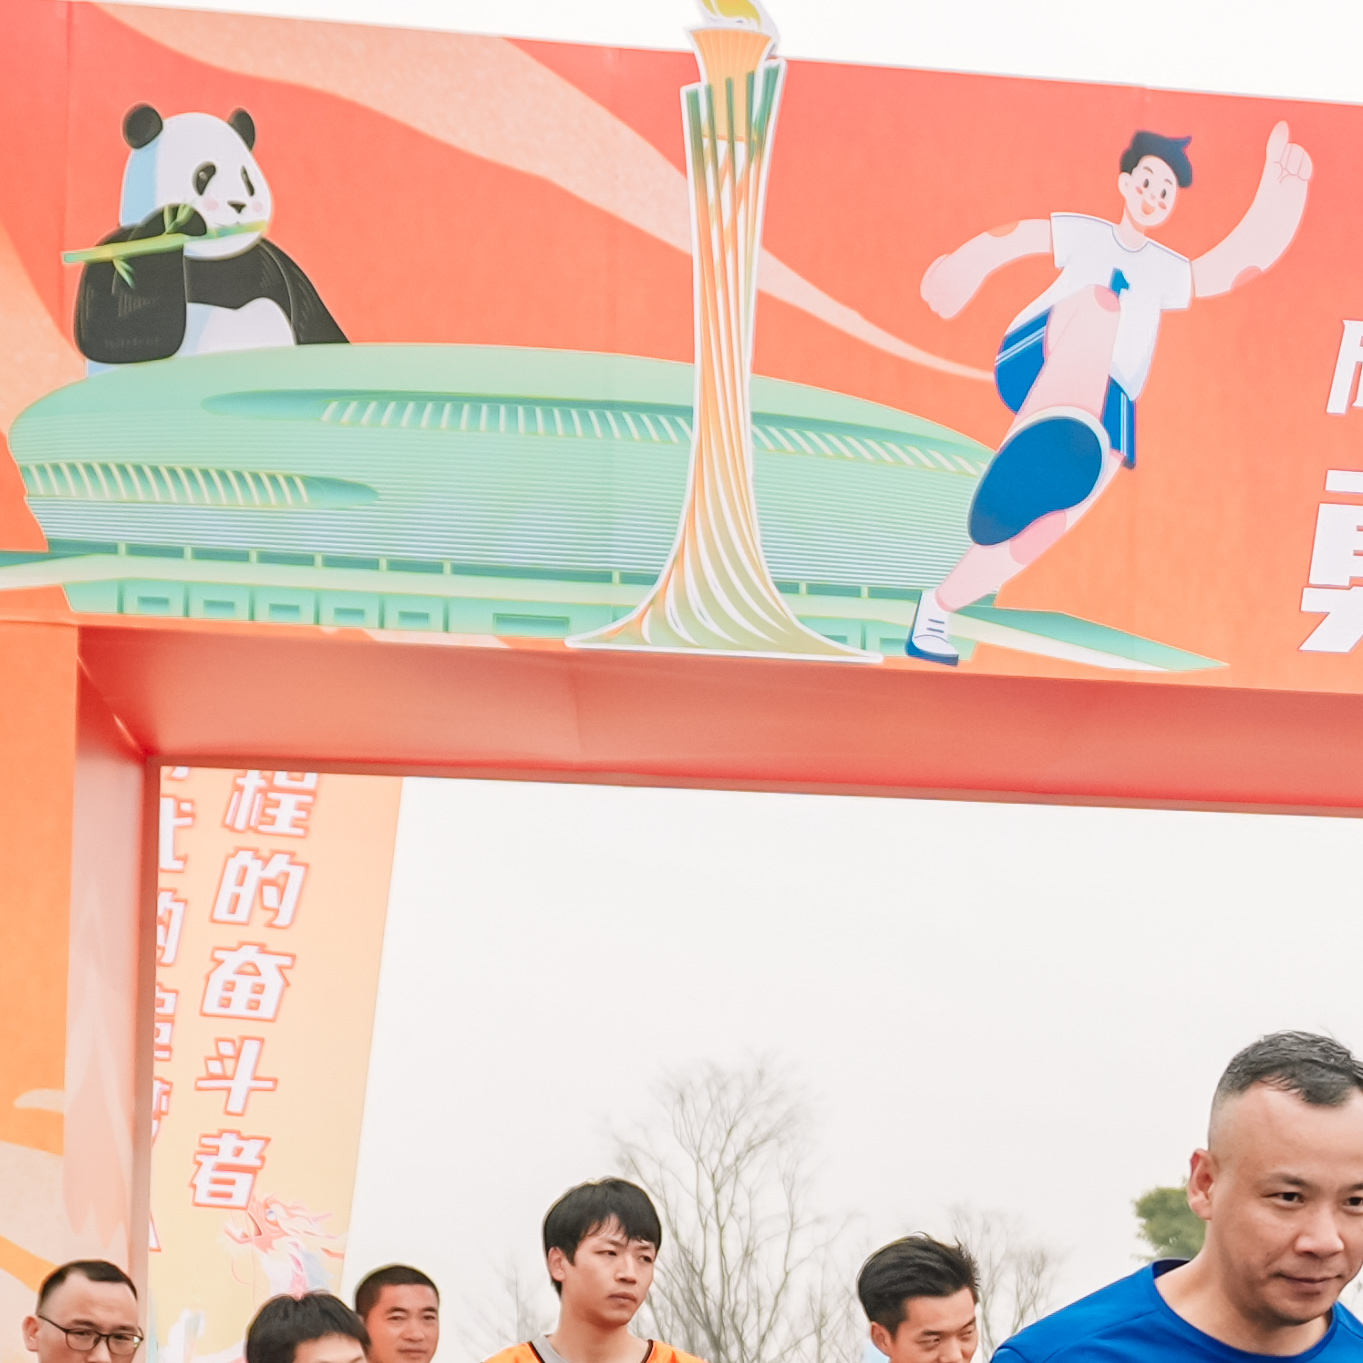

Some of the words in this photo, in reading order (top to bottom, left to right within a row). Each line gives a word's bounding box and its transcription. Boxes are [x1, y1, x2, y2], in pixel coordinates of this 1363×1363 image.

[190, 771, 317, 1209] 程的奋斗者
